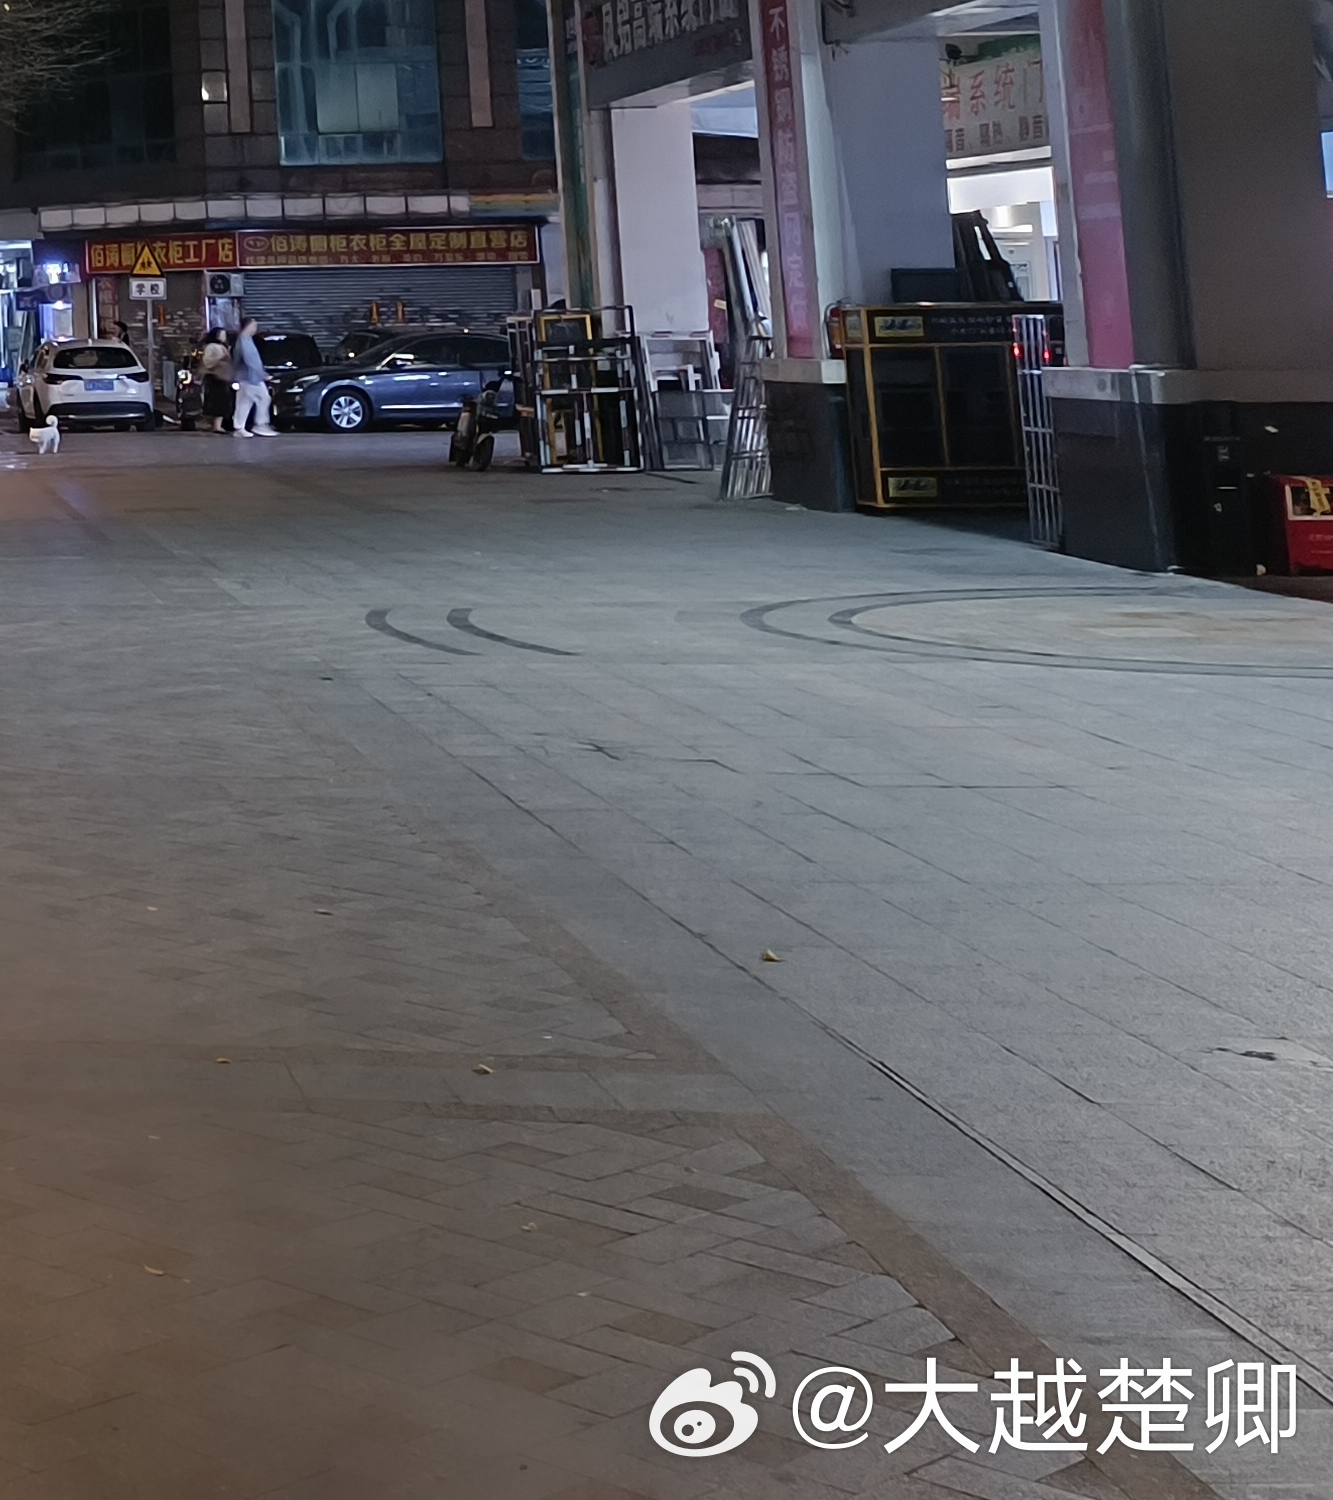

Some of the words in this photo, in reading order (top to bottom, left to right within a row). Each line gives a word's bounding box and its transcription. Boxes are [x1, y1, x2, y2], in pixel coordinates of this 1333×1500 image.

[90, 238, 234, 268] 佰涛橱衣柜工厂店
[135, 282, 161, 295] 学校
